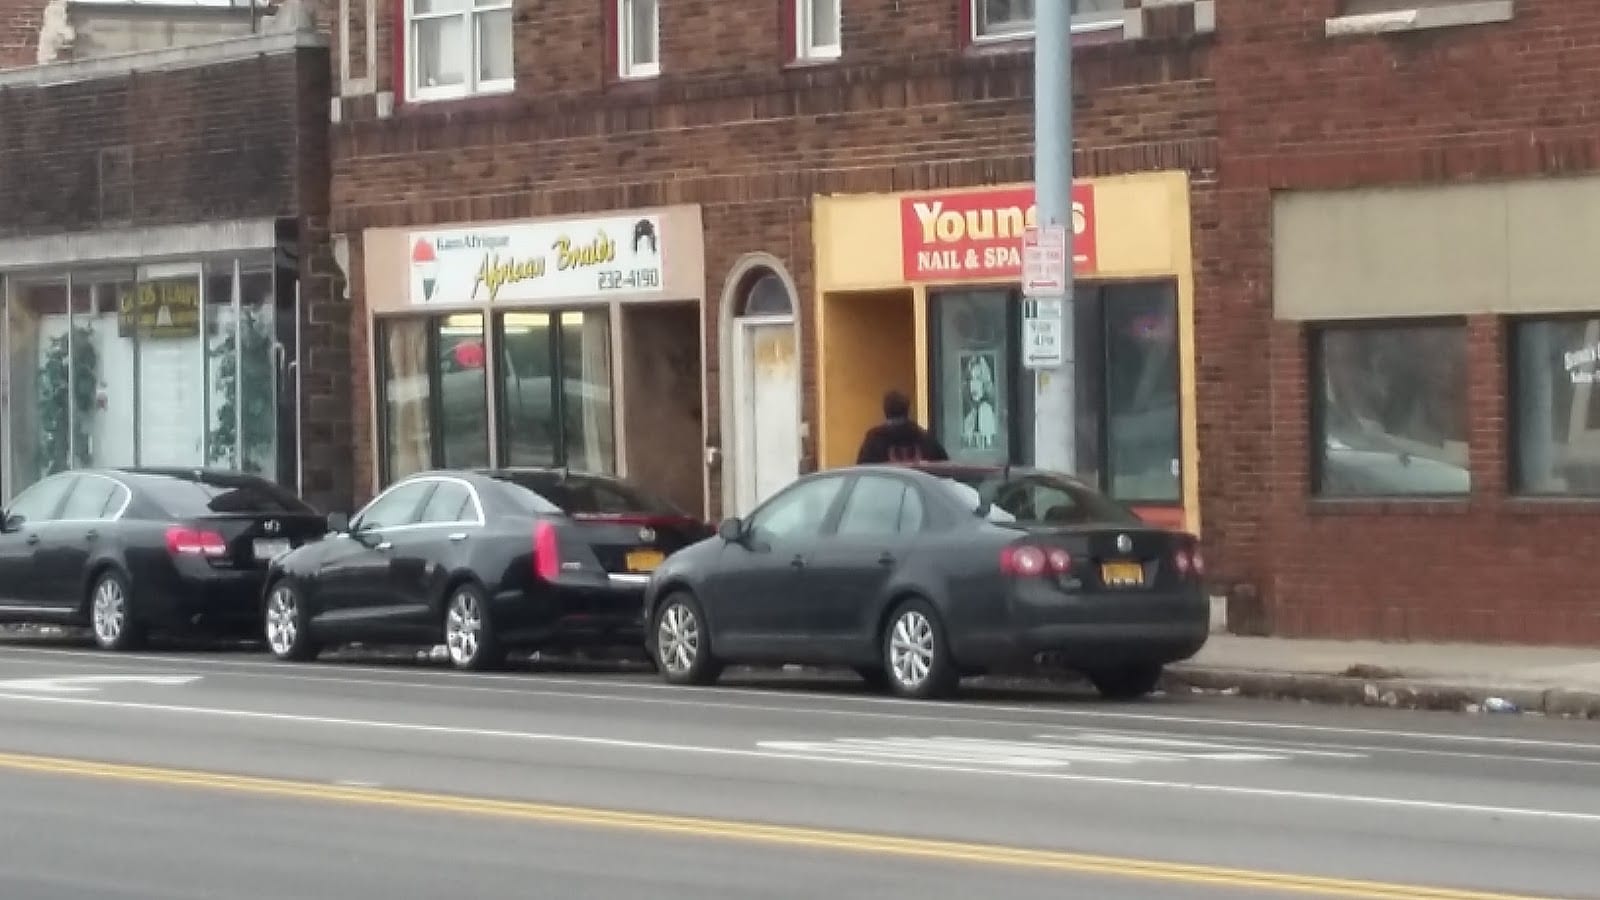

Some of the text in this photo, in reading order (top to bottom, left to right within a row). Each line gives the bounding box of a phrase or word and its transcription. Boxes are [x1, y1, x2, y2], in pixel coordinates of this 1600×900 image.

[551, 229, 616, 271] Braids
[917, 250, 961, 272] NAIL
[964, 249, 979, 269] &
[984, 246, 1021, 269] SPA
[598, 268, 660, 290] 232-4190
